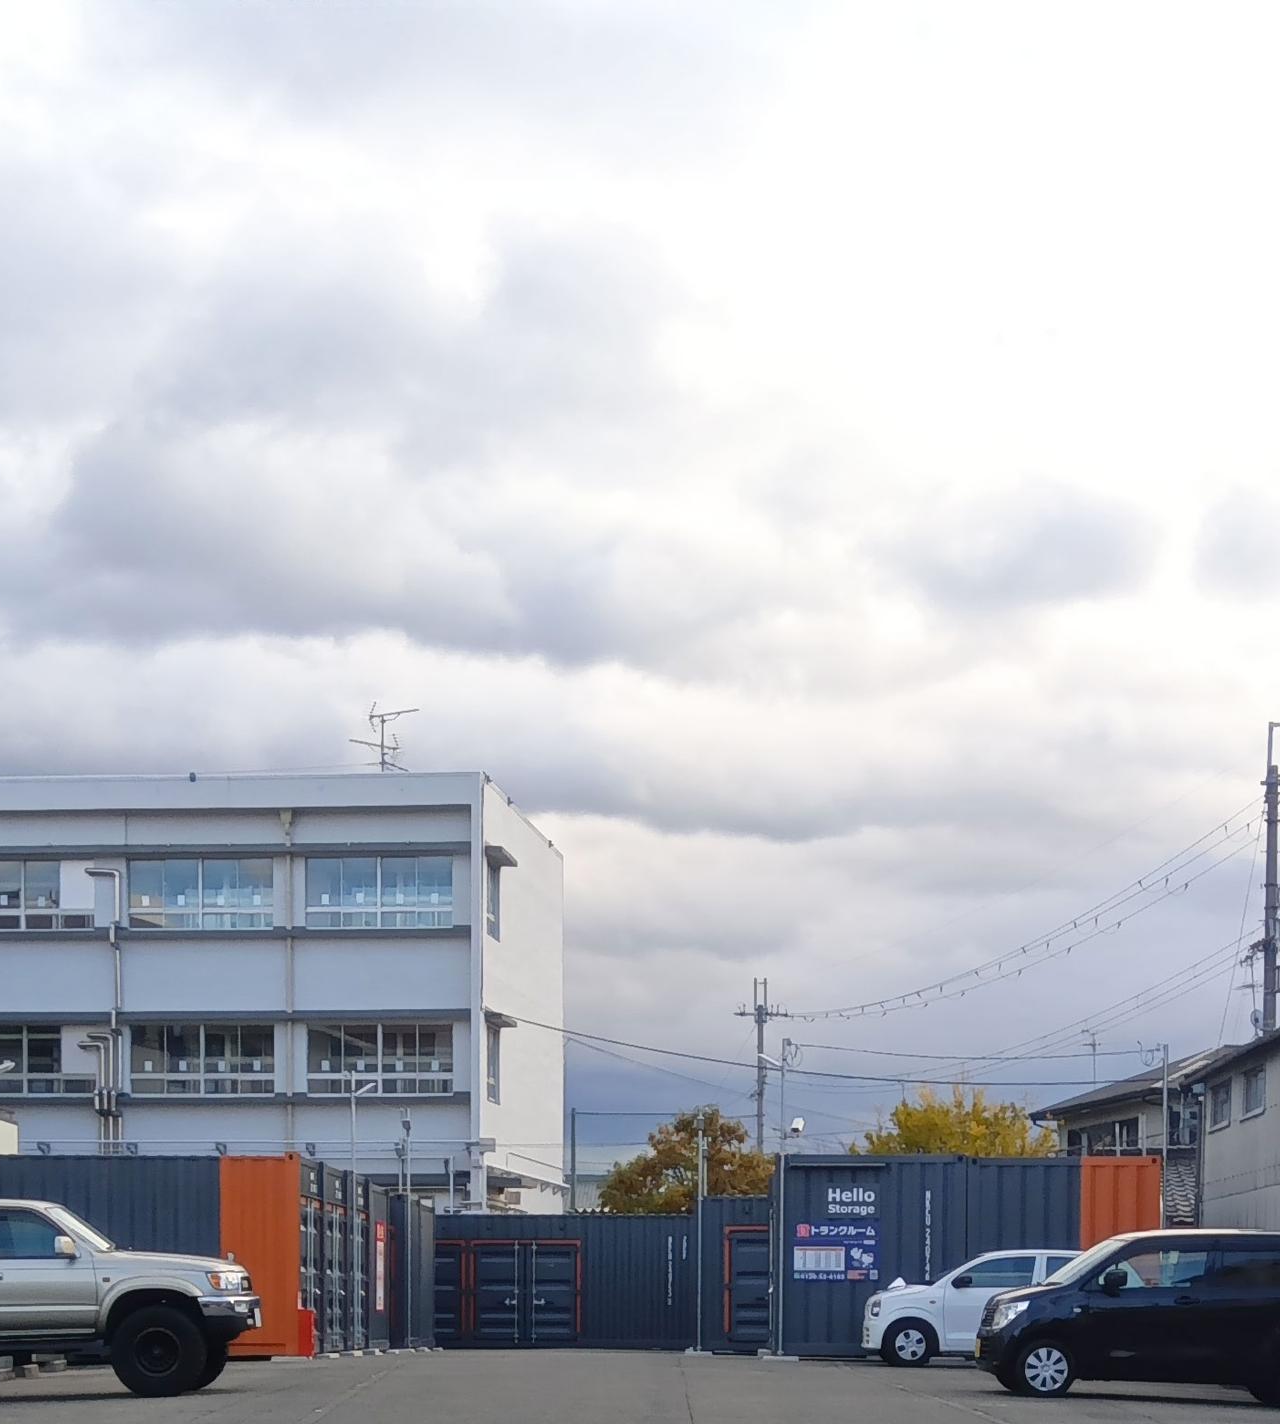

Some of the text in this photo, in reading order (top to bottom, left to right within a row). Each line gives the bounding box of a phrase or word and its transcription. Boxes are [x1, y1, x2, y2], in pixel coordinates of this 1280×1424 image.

[827, 1187, 876, 1203] Hello
[827, 1203, 876, 1216] Storage
[810, 1225, 876, 1236] トランクルーム
